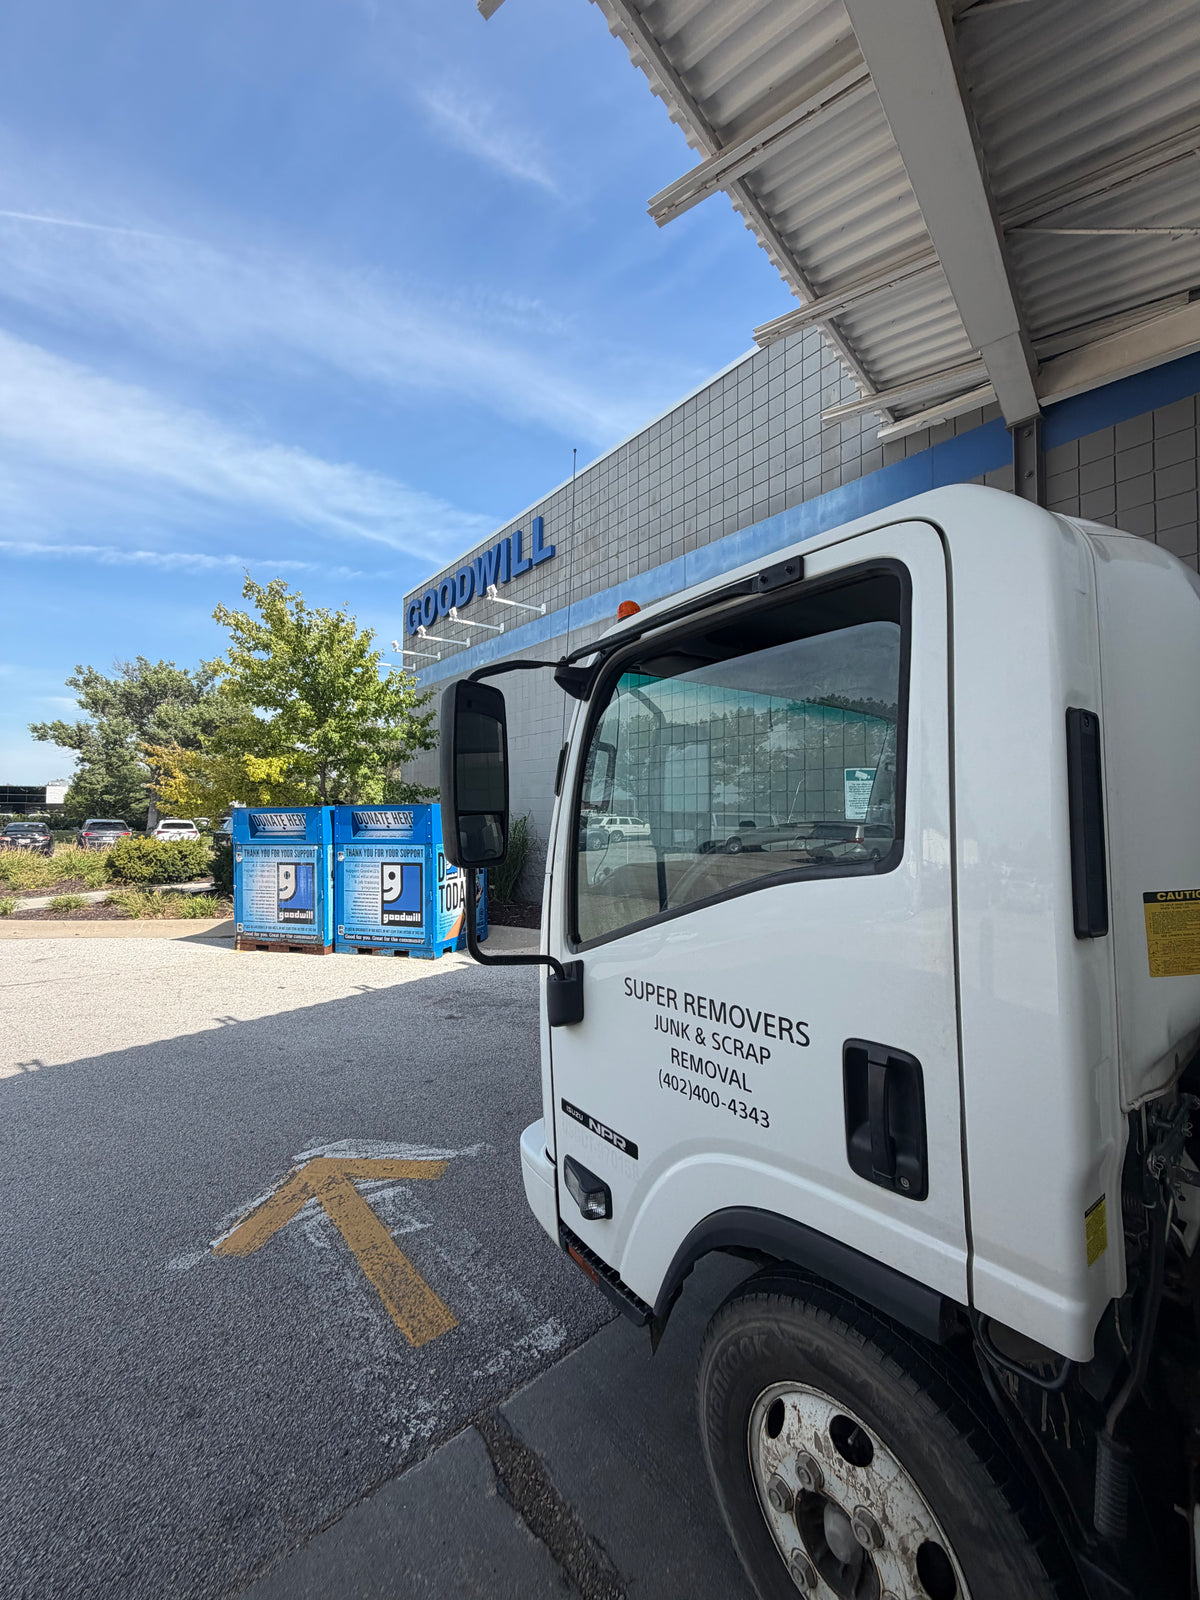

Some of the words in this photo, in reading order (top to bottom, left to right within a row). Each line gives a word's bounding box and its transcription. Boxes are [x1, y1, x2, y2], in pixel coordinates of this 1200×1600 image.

[405, 516, 556, 635] GOODWILL
[252, 814, 287, 827] DONATE
[354, 812, 392, 825] DONATE
[244, 849, 260, 858] THANK
[261, 849, 270, 858] YOU
[271, 849, 280, 858] FOR
[281, 849, 293, 858] YOUR
[294, 849, 315, 858] SUPPORT
[346, 848, 362, 857] THANK
[363, 848, 373, 857] YOU
[374, 848, 384, 858] FOR
[385, 848, 399, 858] YOUR
[400, 848, 424, 858] SUPPORT
[438, 881, 466, 914] TODA
[279, 910, 314, 921] goodwill
[383, 912, 421, 924] goodwill
[623, 976, 679, 1011] SUPER
[683, 992, 812, 1048] REMOVERS
[653, 1014, 691, 1042] JUNK
[694, 1026, 707, 1047] &
[711, 1032, 772, 1065] SCRAP
[670, 1047, 753, 1094] REMOVAL
[658, 1068, 771, 1129] (402)400-4343
[566, 1105, 584, 1121] ISUZU
[588, 1118, 627, 1152] NPR
